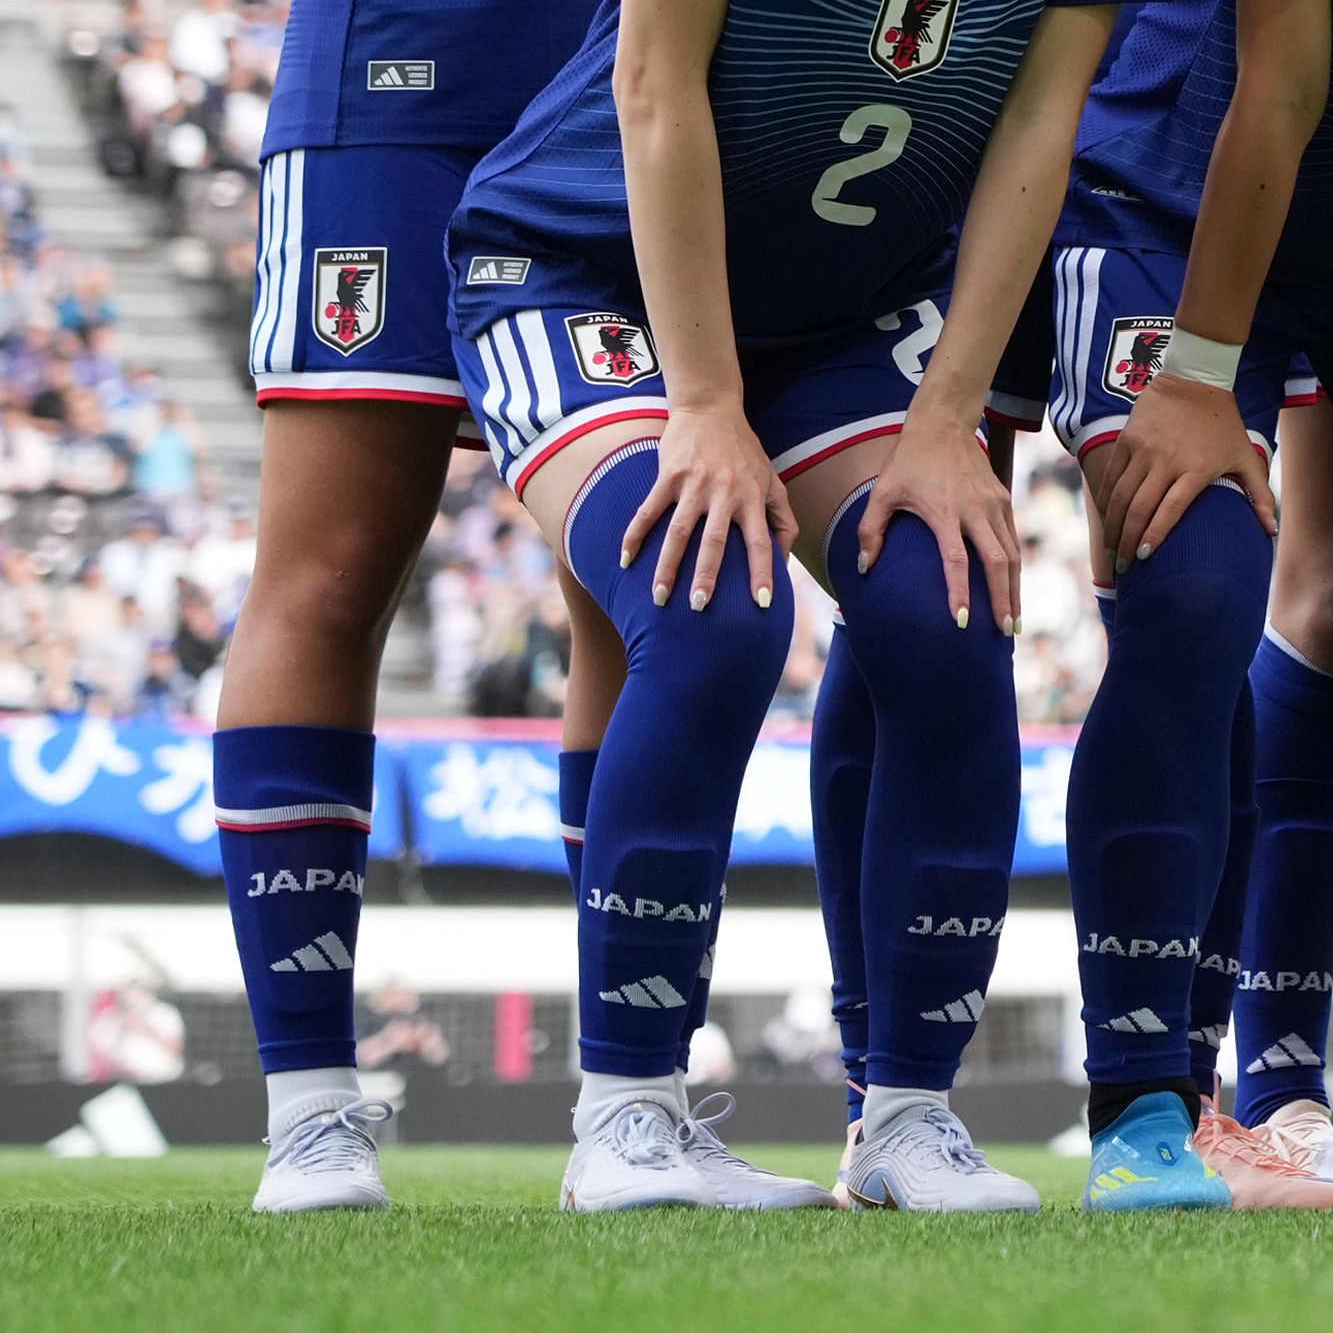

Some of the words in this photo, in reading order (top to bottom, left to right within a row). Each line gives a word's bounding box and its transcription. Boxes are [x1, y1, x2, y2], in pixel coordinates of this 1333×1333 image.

[887, 45, 921, 64] JFA
[812, 104, 913, 226] 2
[332, 252, 368, 262] JAPAN
[331, 319, 361, 335] JFA
[585, 315, 628, 324] JAPAN
[606, 361, 641, 376] JFA
[586, 888, 712, 922] JAPAN
